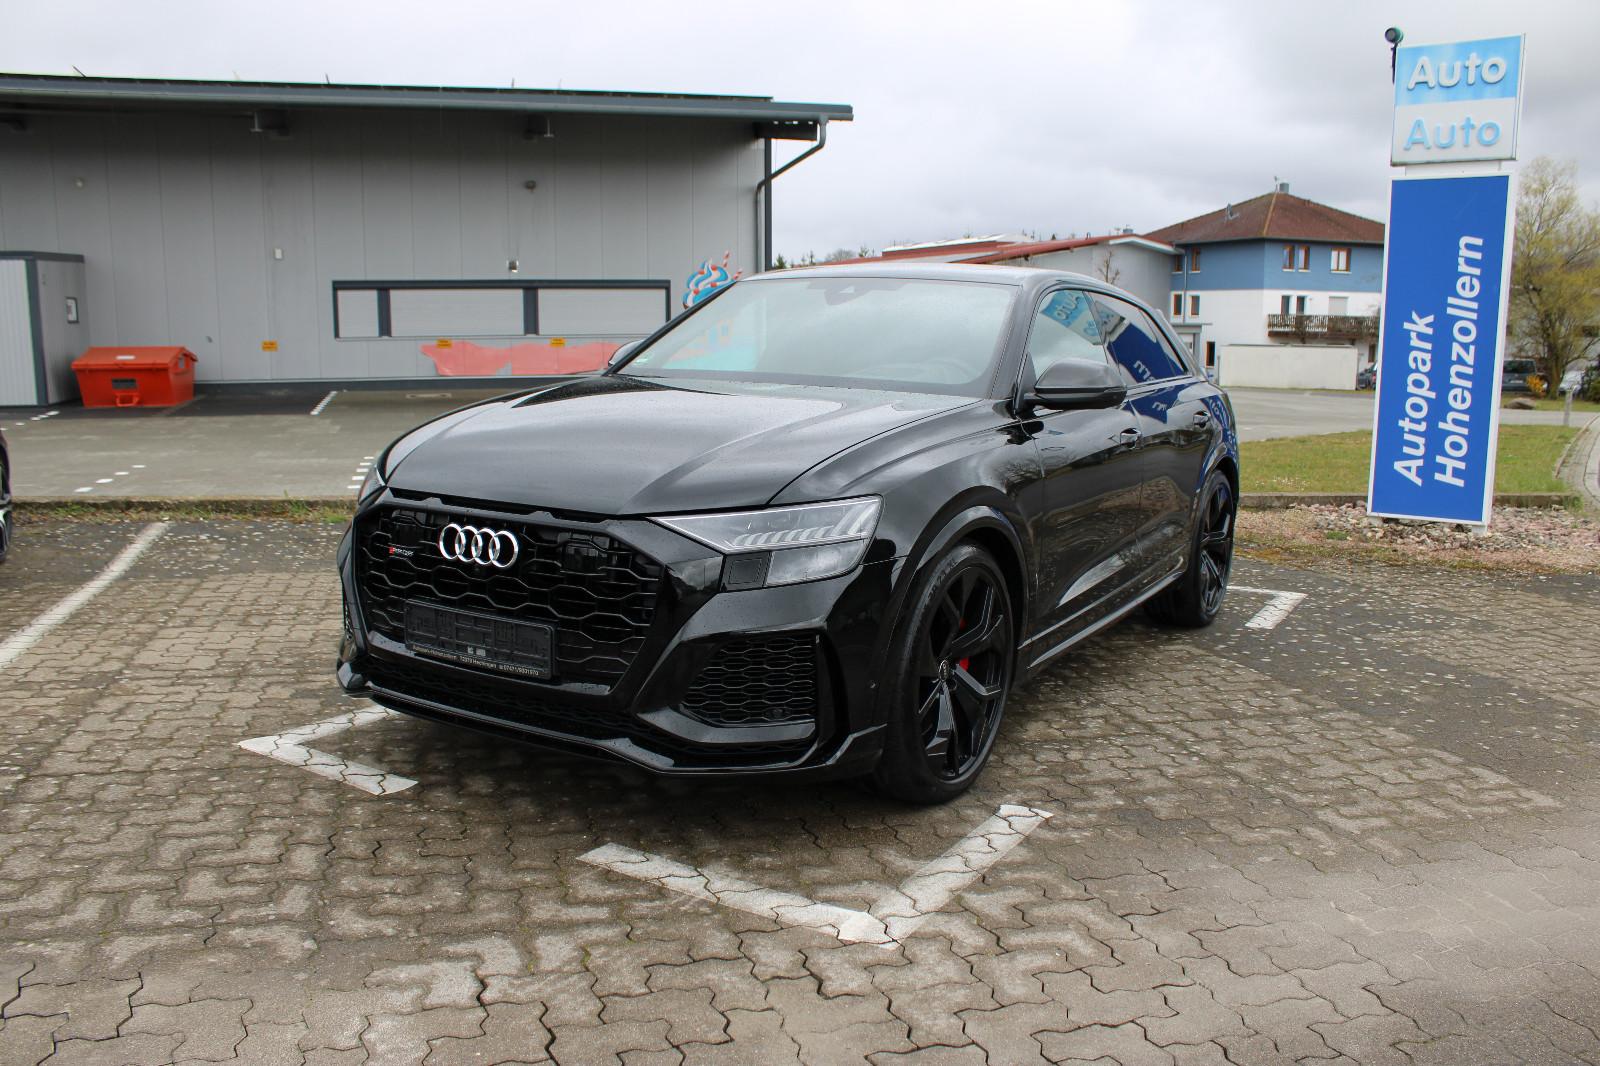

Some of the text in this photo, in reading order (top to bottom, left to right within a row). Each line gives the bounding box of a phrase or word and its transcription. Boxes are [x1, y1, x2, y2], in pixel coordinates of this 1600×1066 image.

[1406, 52, 1507, 91] Auto
[1402, 116, 1502, 151] Auto
[1394, 310, 1436, 487] Autopark
[1434, 235, 1483, 488] Hohenzollern
